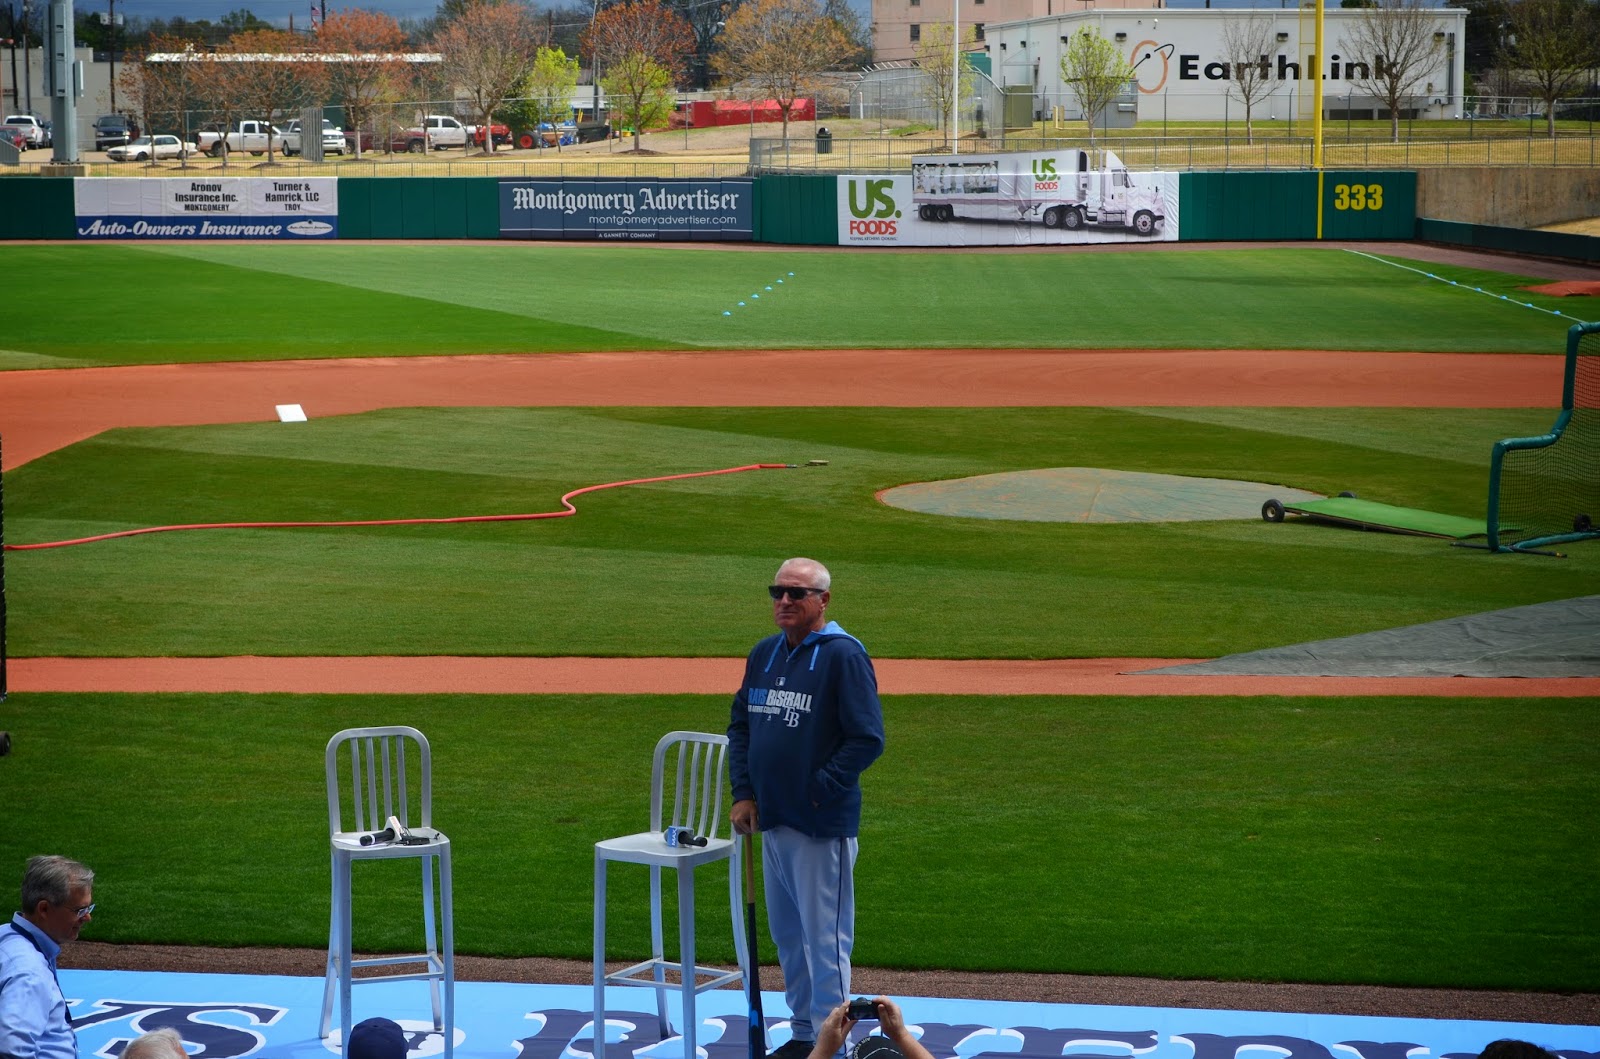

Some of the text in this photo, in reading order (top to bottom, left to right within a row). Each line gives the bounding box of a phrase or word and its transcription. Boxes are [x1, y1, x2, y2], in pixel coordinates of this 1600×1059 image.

[1179, 54, 1400, 80] EarthLink
[191, 182, 222, 192] Aronov
[273, 182, 310, 192] Turner &
[1034, 182, 1058, 190] FOODS
[175, 193, 238, 202] Insurance Inc.
[306, 192, 319, 202] LLC
[512, 187, 740, 215] Montgomery Advertiser
[1334, 184, 1383, 211] 333
[184, 203, 229, 211] MONTGOMERY
[285, 203, 301, 211] TROY
[589, 214, 737, 226] montgomeryadvertiser.com
[78, 219, 282, 236] Auto-Owners Insurance
[849, 220, 897, 236] FOODS
